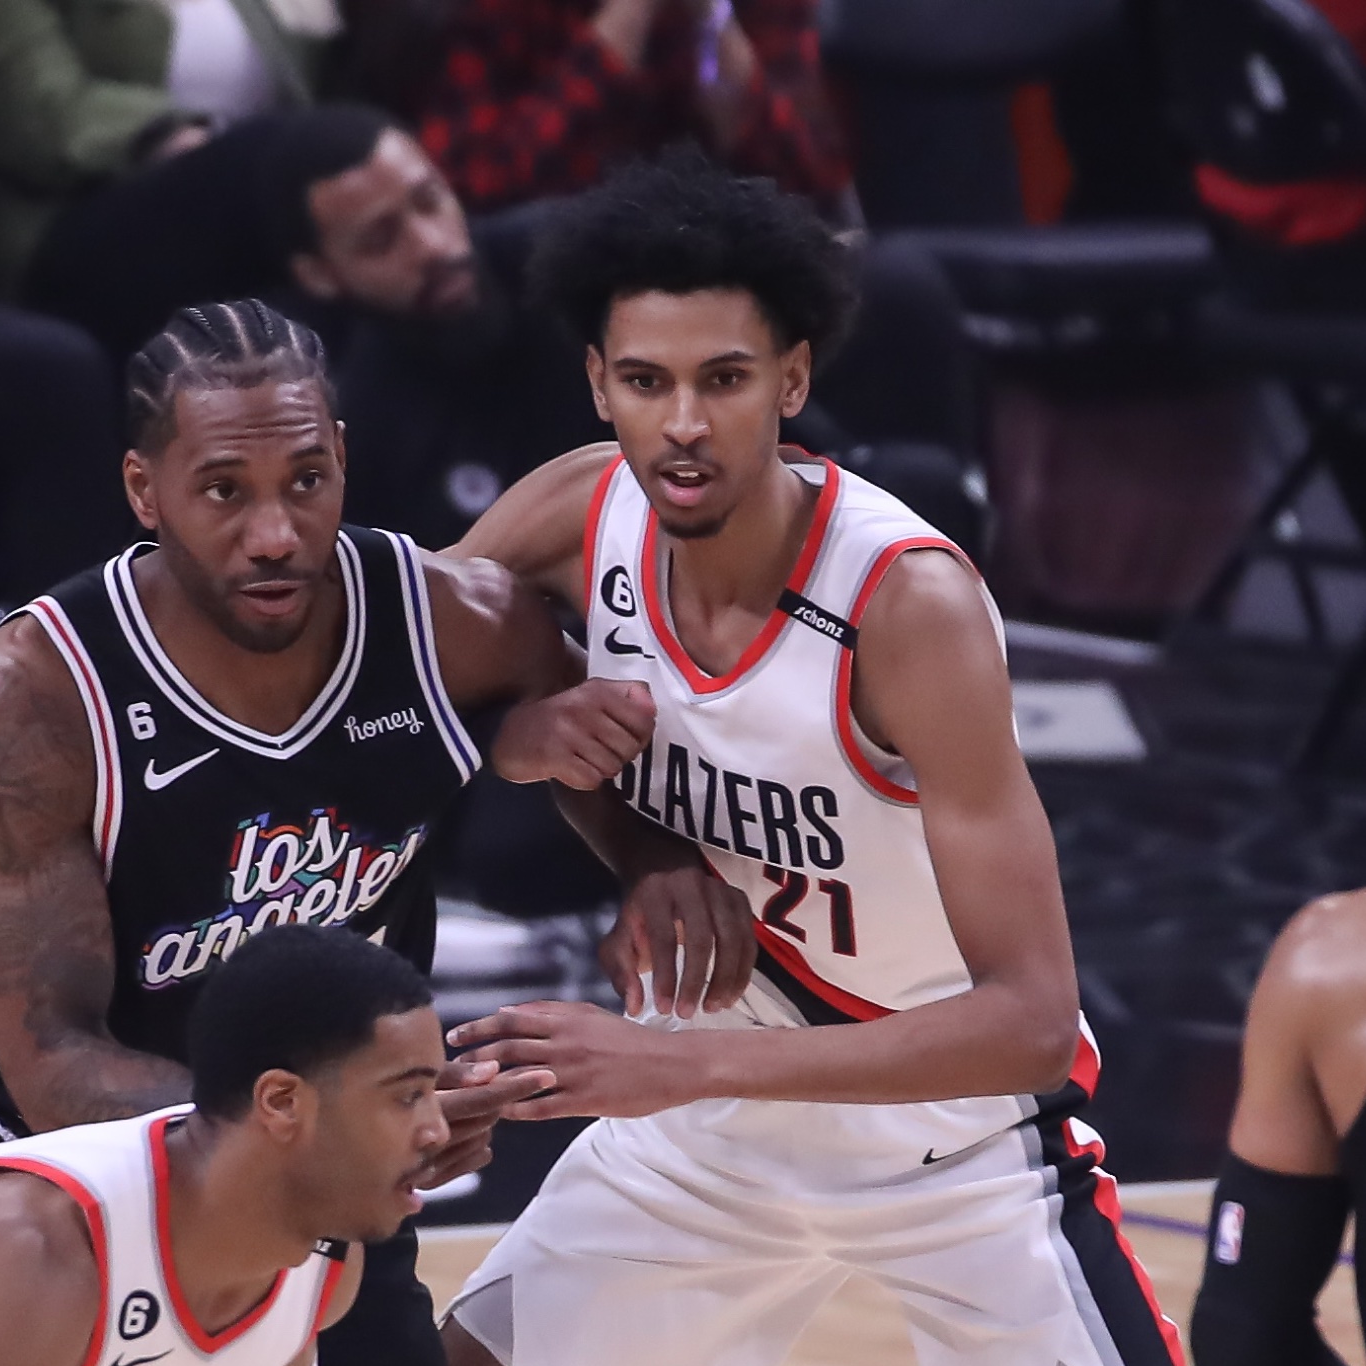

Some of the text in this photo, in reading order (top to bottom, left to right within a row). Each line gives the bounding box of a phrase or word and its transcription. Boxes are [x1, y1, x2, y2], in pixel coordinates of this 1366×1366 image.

[610, 571, 636, 613] 6
[125, 700, 158, 741] 6
[343, 705, 425, 744] honey
[229, 811, 352, 905] los
[761, 863, 858, 957] 21
[123, 1292, 152, 1339] 6
